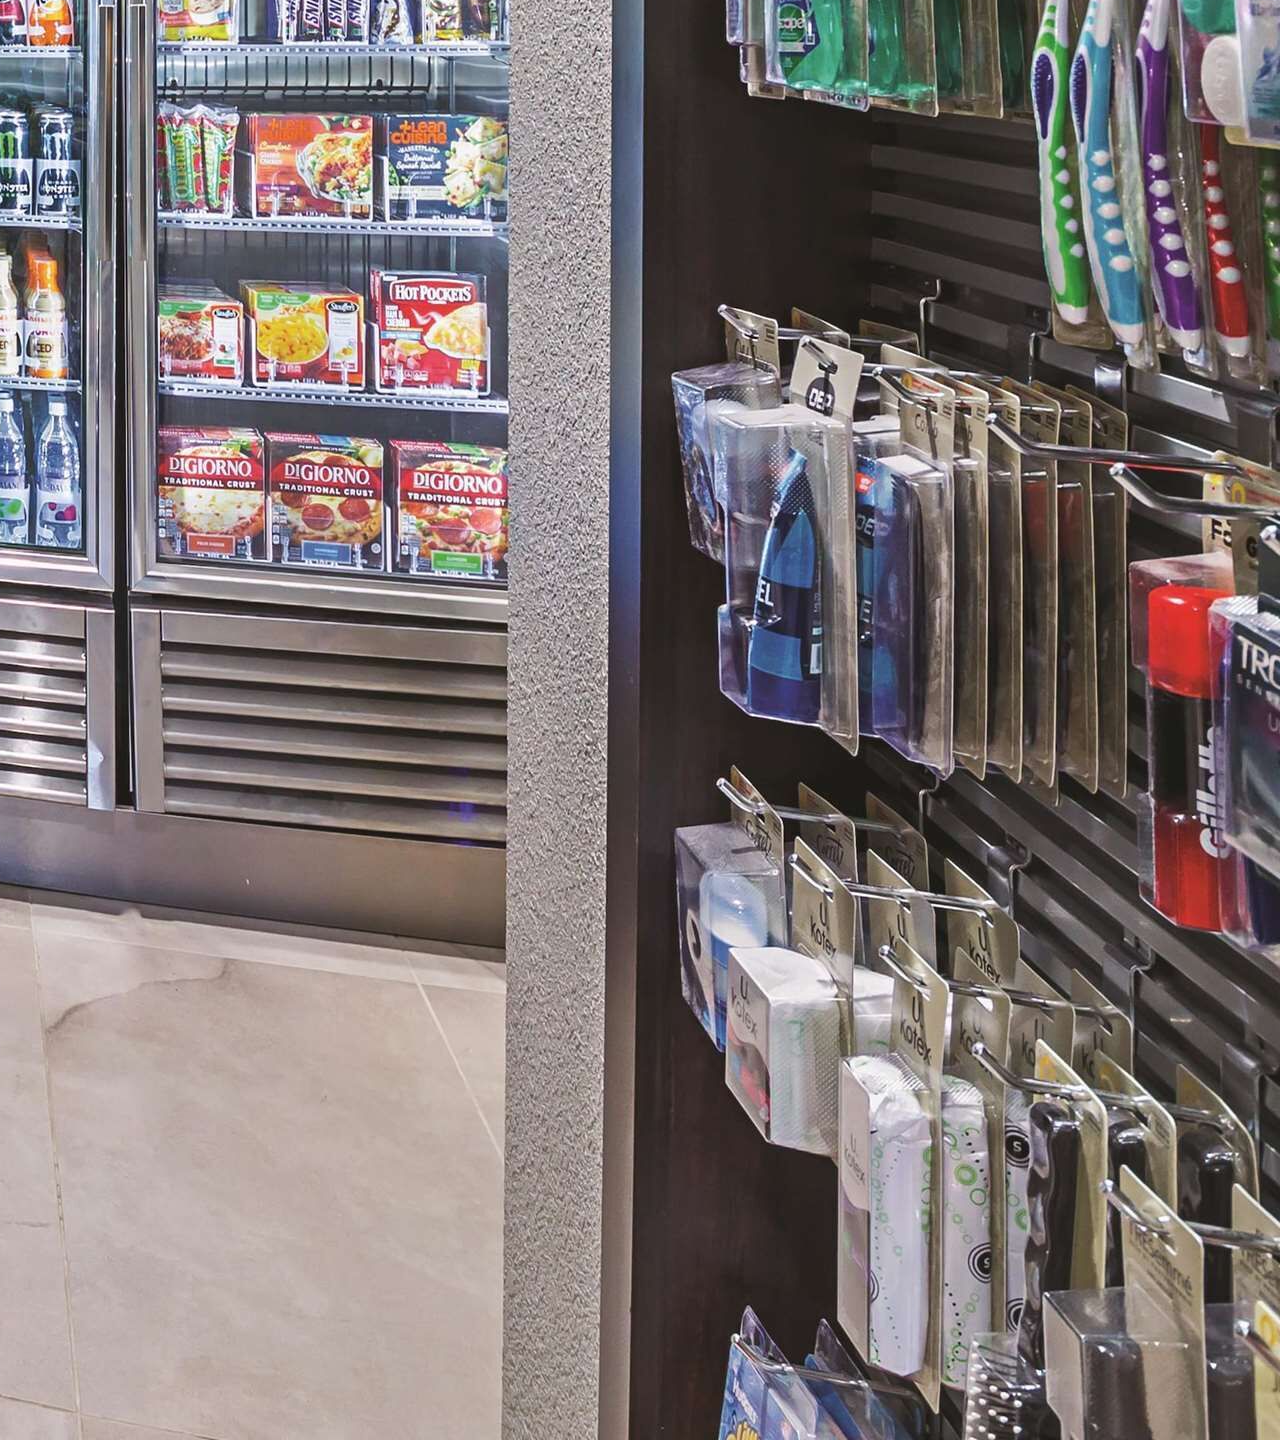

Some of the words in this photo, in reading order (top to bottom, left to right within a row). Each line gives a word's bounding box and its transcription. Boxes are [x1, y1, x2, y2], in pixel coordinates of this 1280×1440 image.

[394, 284, 420, 300] HOT
[419, 284, 472, 303] POCKETS
[168, 456, 252, 478] DIGIORNO
[284, 462, 370, 486] DIGIORNO
[164, 476, 225, 489] TRADITIONAL
[226, 479, 257, 489] CRUST
[278, 482, 341, 496] TRADITIONAL
[343, 487, 375, 498] CRUST
[413, 470, 503, 495] DIGIORNO
[407, 492, 474, 505] TRADITIONAL
[475, 497, 507, 507] CRUST
[810, 920, 838, 959] kotex
[968, 943, 1001, 984] kotex
[729, 991, 758, 1039] kotex
[899, 1019, 933, 1060] kotex
